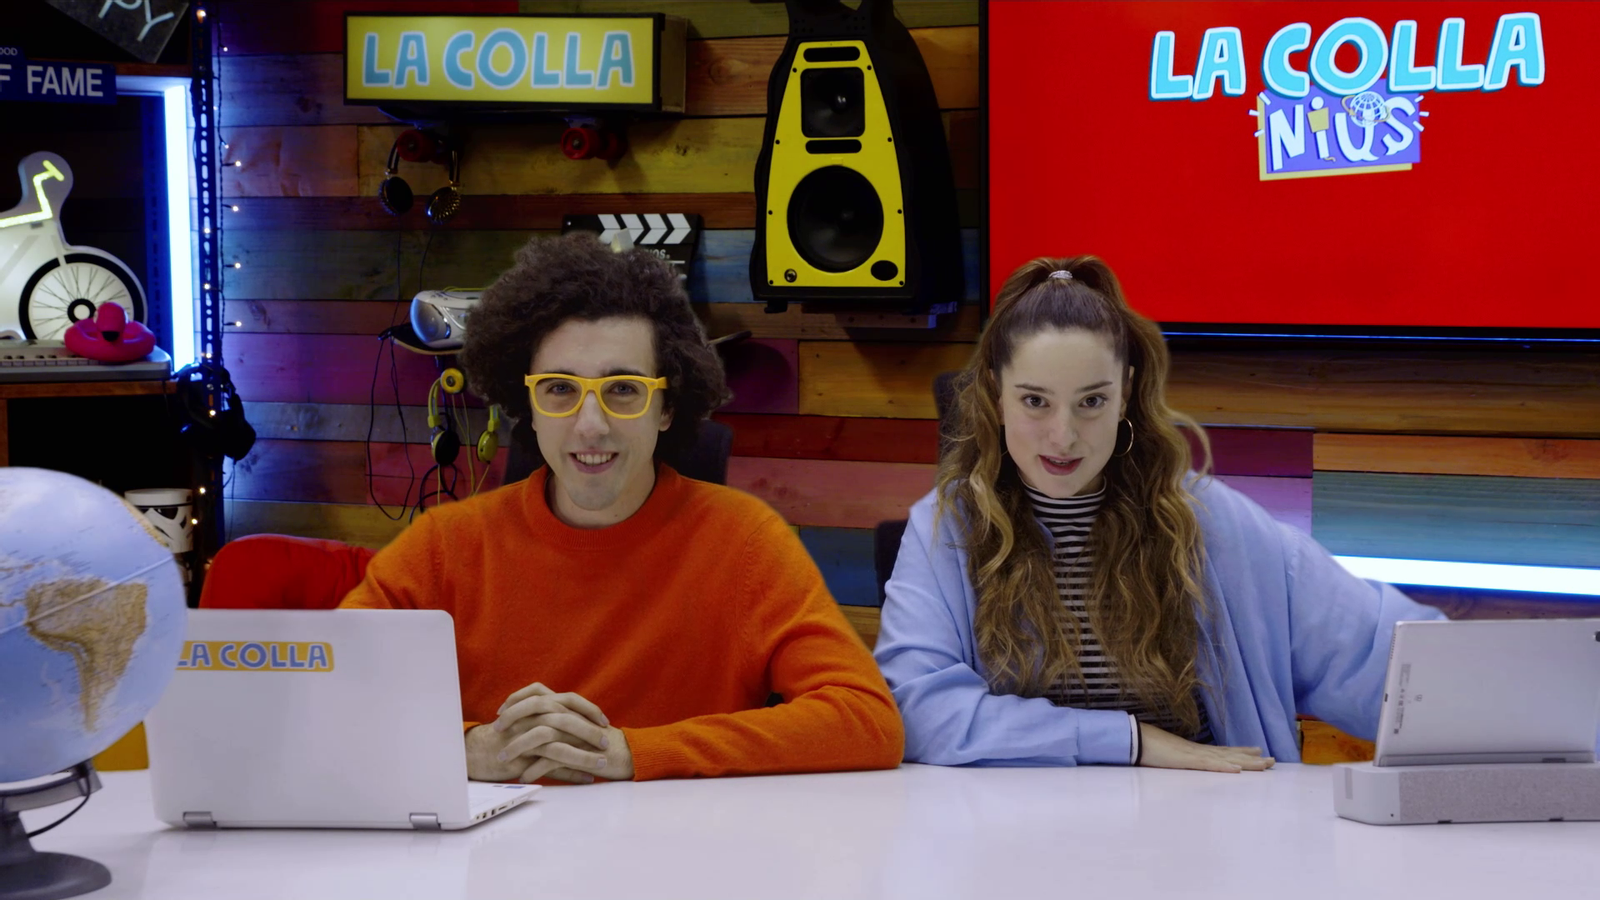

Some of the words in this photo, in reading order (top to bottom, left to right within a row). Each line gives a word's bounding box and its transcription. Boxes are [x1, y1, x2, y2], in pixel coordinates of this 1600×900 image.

[362, 30, 430, 89] LA
[442, 27, 635, 91] COLLA
[1149, 26, 1247, 101] LA
[1261, 12, 1546, 98] COLLA
[26, 65, 104, 97] FAME
[219, 642, 329, 670] COLLA
